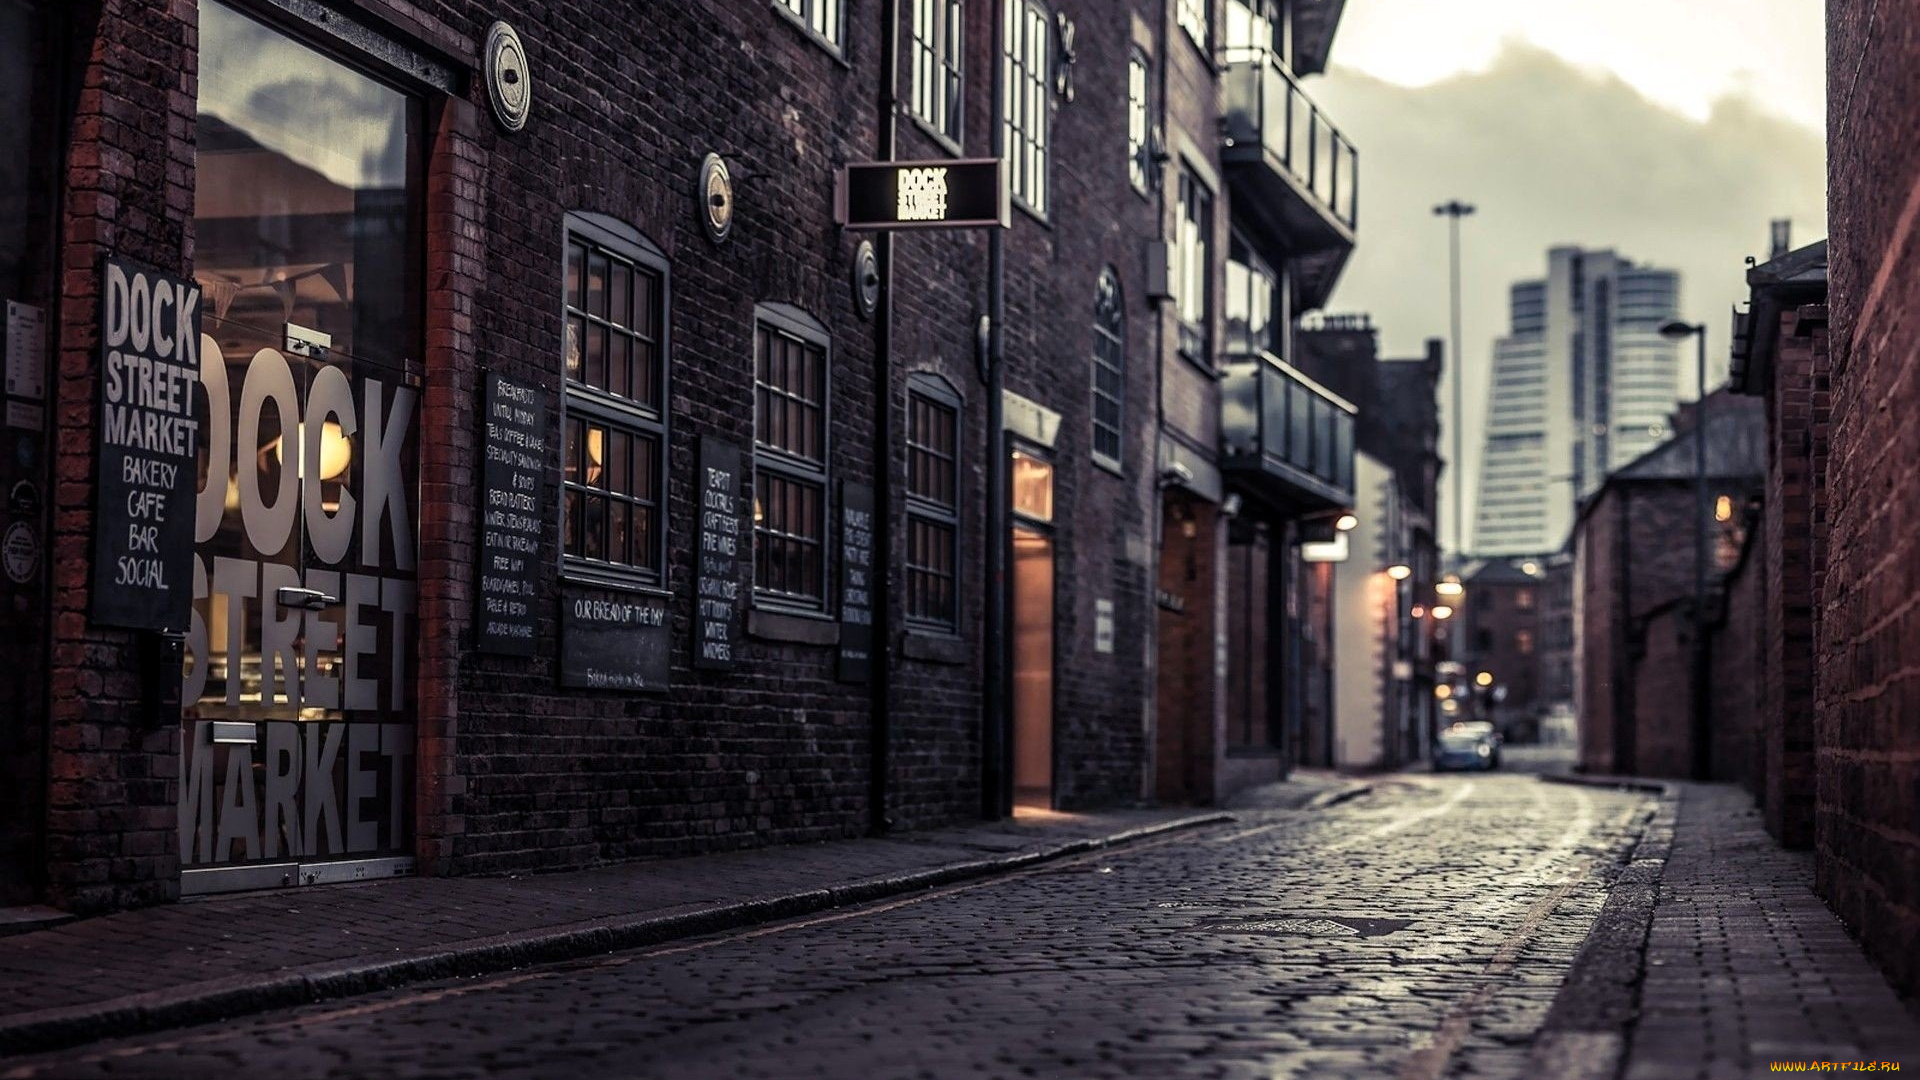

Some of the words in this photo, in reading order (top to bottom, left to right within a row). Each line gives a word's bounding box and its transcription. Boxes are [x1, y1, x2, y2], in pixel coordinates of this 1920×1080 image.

[897, 167, 948, 193] DOCK
[106, 263, 200, 366] DOCK
[105, 350, 199, 417] STREET
[104, 402, 199, 458] MARKET
[122, 455, 178, 490] BAKERY
[127, 490, 166, 523] CAFE
[128, 523, 160, 554] BAR
[115, 555, 170, 590] SOCIAL
[493, 555, 510, 571] FREE
[574, 599, 592, 620] OUR
[593, 600, 621, 622] BREAD
[621, 604, 632, 623] OF
[634, 605, 650, 625] THE
[650, 607, 664, 627] DAY
